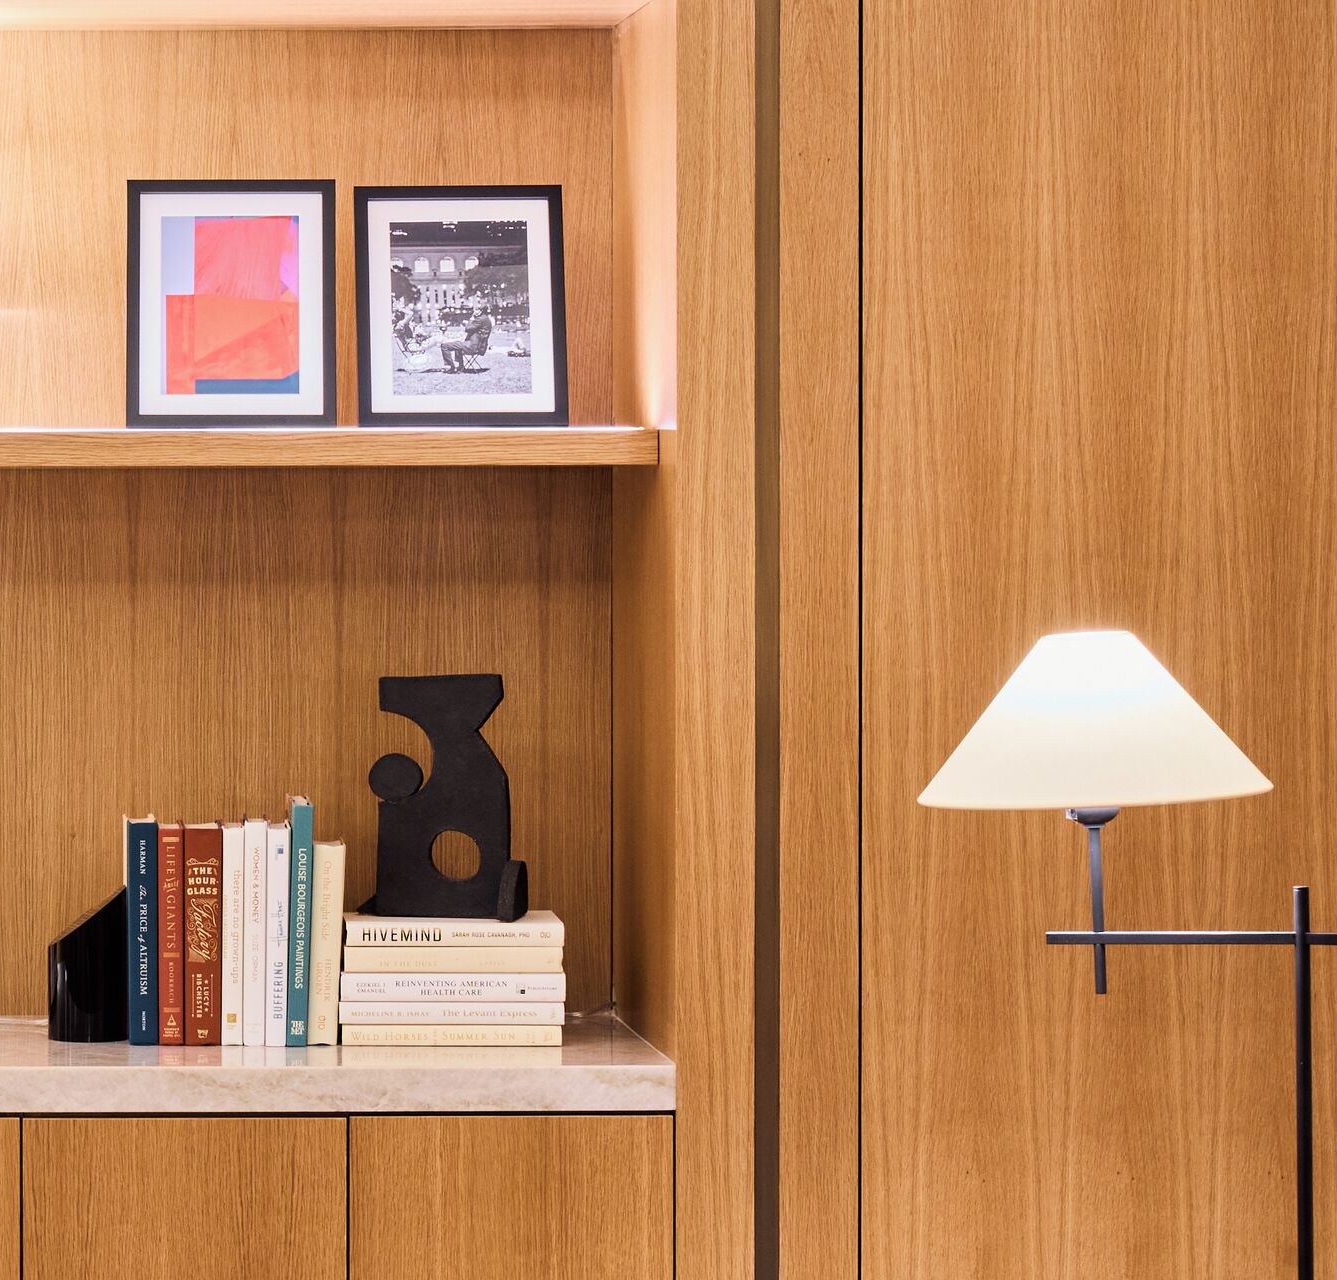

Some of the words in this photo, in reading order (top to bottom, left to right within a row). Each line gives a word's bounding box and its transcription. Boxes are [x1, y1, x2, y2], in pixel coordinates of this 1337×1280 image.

[166, 846, 176, 879] LIFE
[193, 866, 213, 875] THE
[252, 846, 260, 881] WOMEN
[297, 848, 307, 881] LOUISE
[324, 860, 333, 875] On
[139, 884, 147, 902] The
[186, 887, 218, 896] GLASS
[188, 877, 219, 886] HOUR-
[233, 870, 241, 896] there
[323, 877, 332, 891] the
[139, 904, 148, 932] PRICE
[251, 891, 259, 924] MONEY
[296, 884, 306, 939] BOURGEOIS
[321, 893, 332, 920] Bright
[166, 895, 176, 949] GIANTS
[190, 898, 217, 962] Factory
[233, 916, 239, 929] no
[321, 921, 331, 940] Side
[362, 927, 442, 942] HIVEMIND
[137, 934, 145, 944] of
[139, 944, 148, 995] ALTRUISM
[231, 931, 240, 984] grown-ups
[294, 940, 304, 989] PAINTINGS
[273, 961, 283, 1019] BUFFERING
[324, 959, 332, 1002] HENDRIK
[395, 980, 457, 988] REINVENTING
[460, 980, 508, 988] AMERICAN
[420, 988, 456, 996] HEALTH
[458, 988, 483, 996] CARE
[195, 973, 203, 1018] RIBCHESTER
[441, 1009, 460, 1017] The
[463, 1009, 496, 1017] Levant
[499, 1010, 538, 1019] Express
